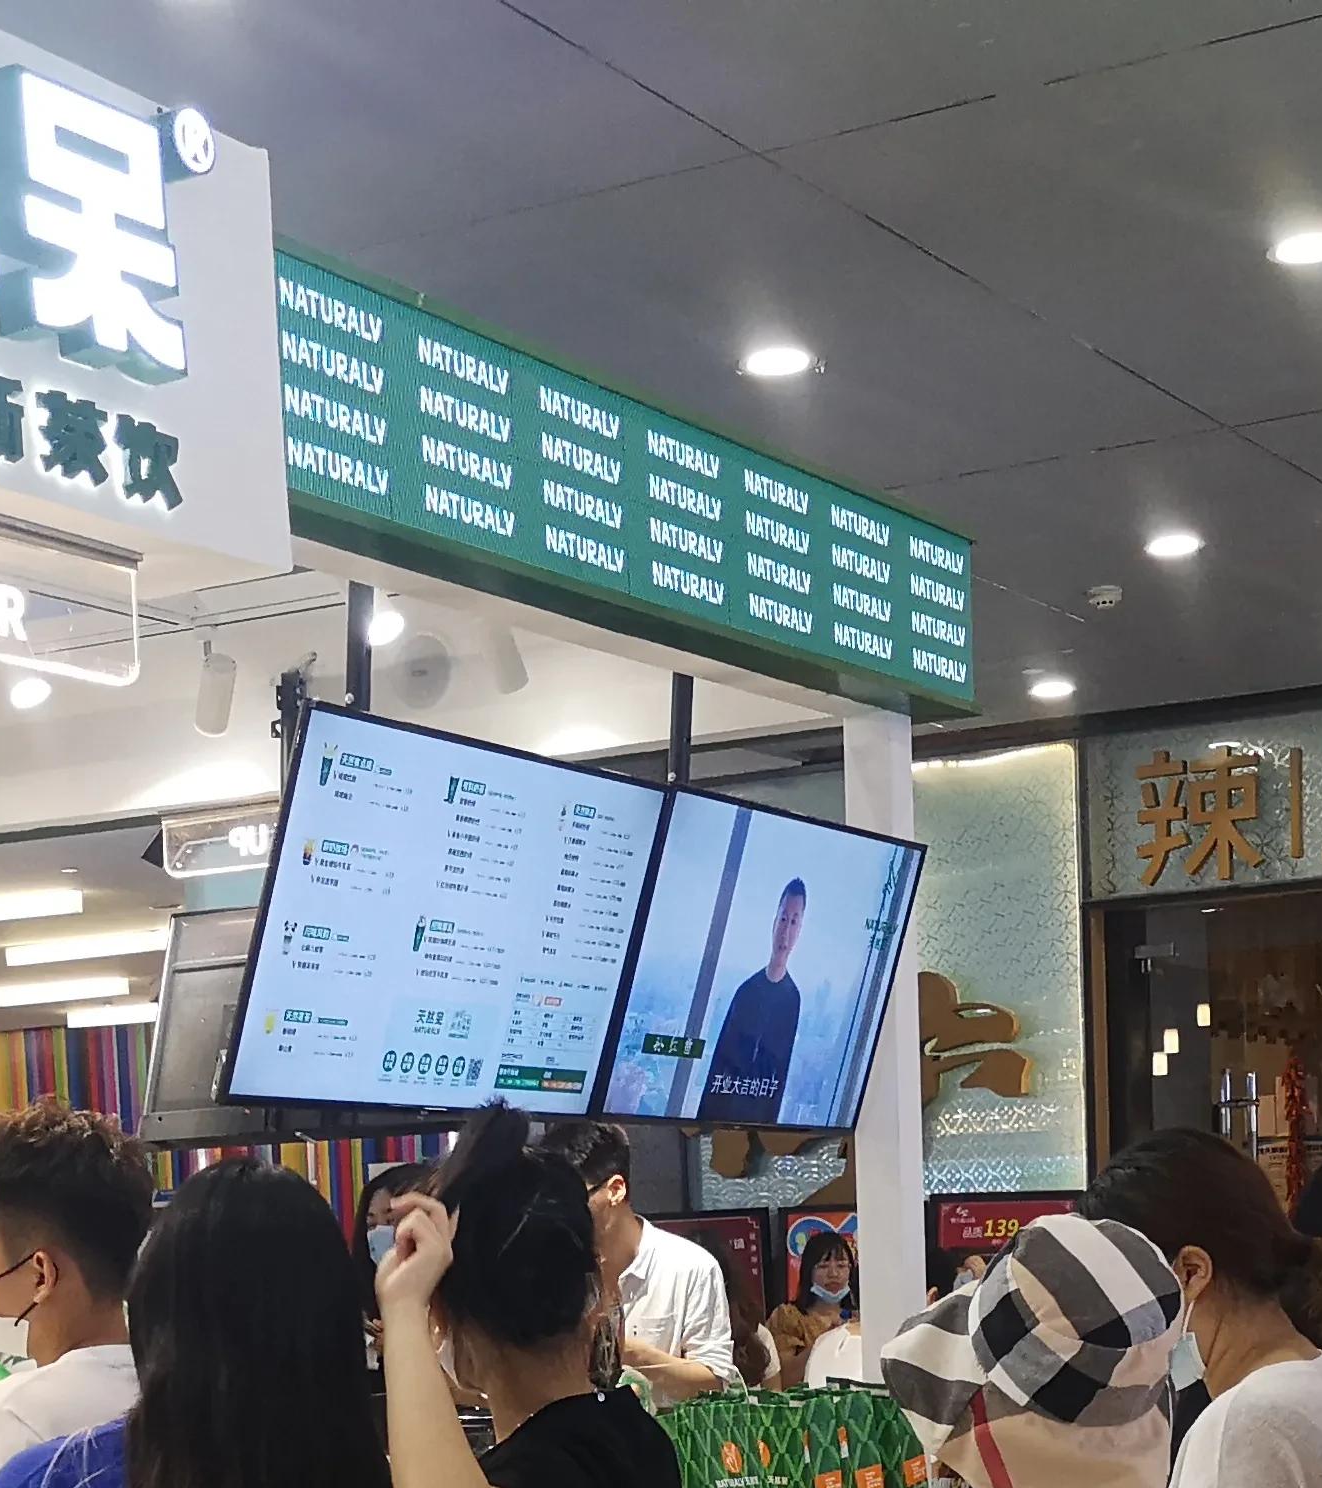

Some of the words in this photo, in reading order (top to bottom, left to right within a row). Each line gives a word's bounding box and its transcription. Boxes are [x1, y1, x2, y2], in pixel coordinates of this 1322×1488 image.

[710, 1073, 780, 1098] 开业大吉的日子
[983, 1218, 1020, 1238] 139
